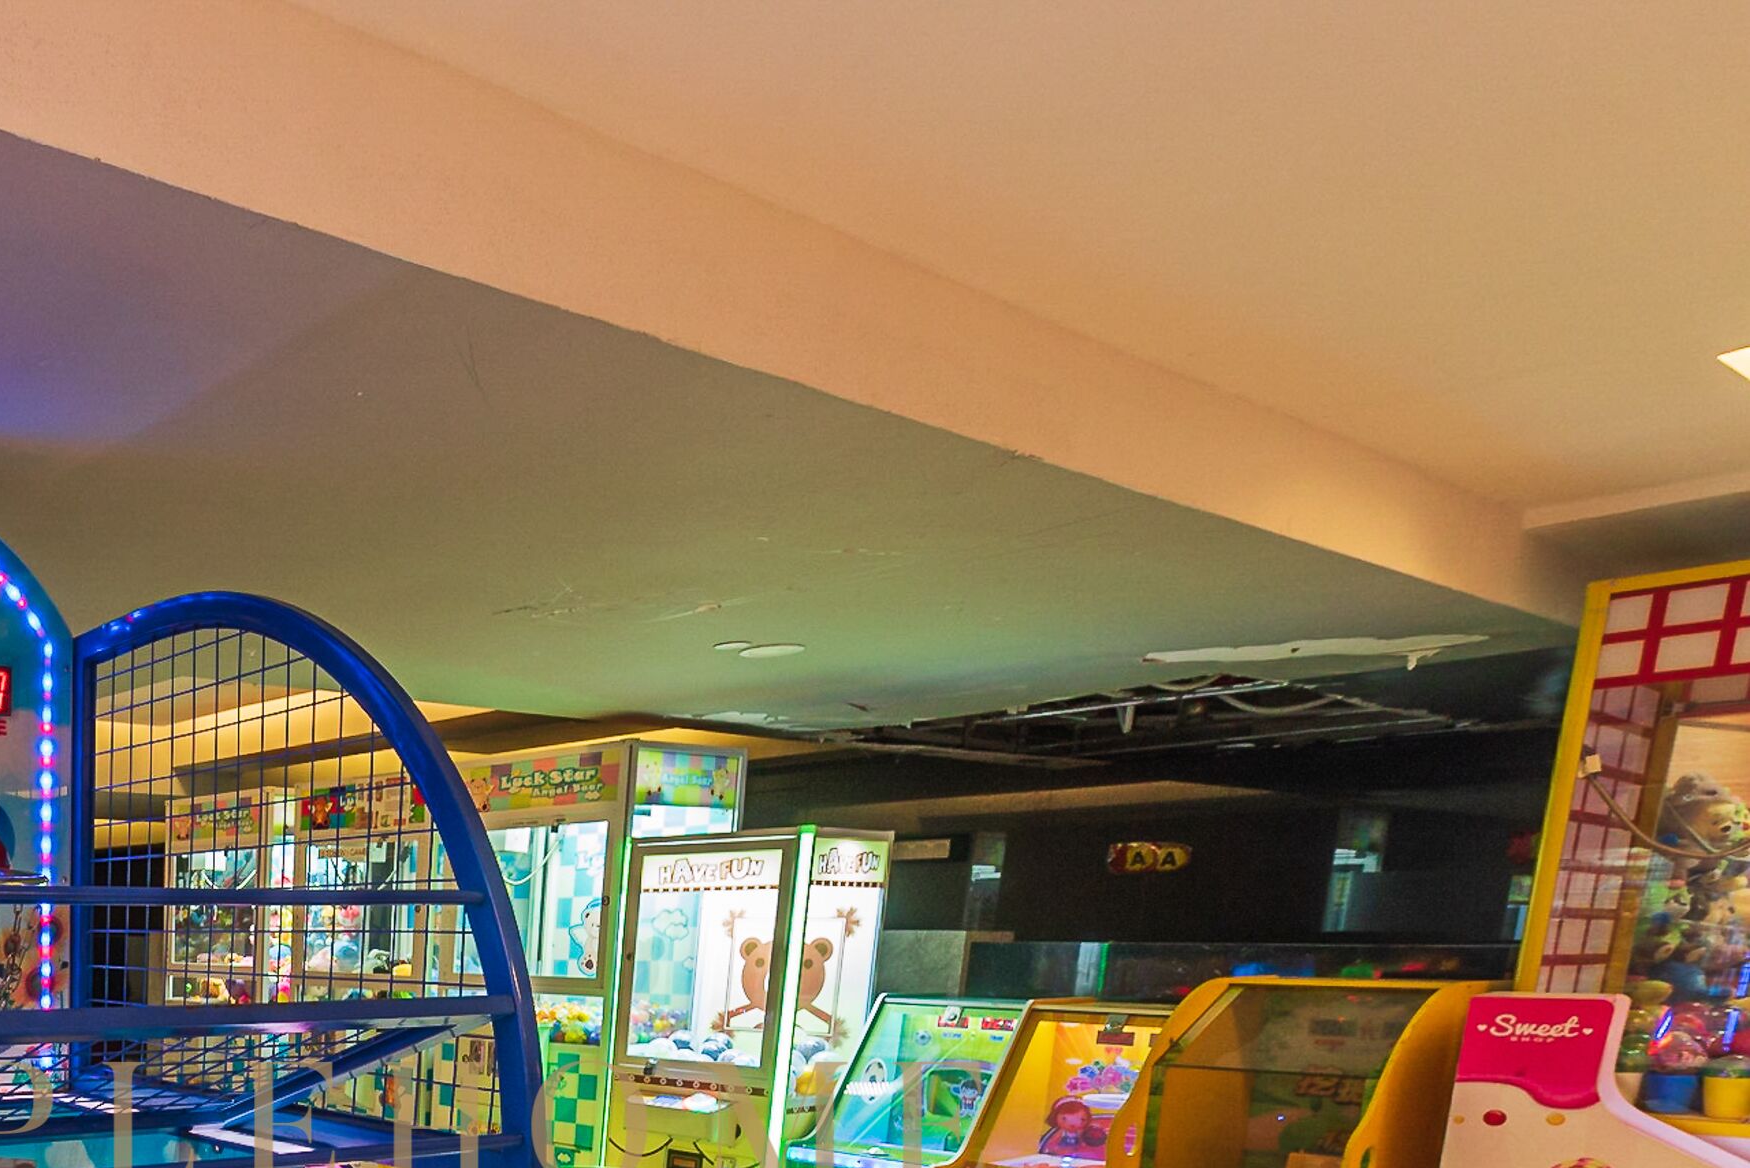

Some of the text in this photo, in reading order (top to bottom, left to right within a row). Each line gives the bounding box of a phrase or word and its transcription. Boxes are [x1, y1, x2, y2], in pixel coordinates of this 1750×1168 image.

[549, 767, 599, 784] Star
[658, 856, 764, 885] HAVE FUN
[818, 848, 880, 875] HAVE FUN
[1489, 1013, 1580, 1038] Sweet
